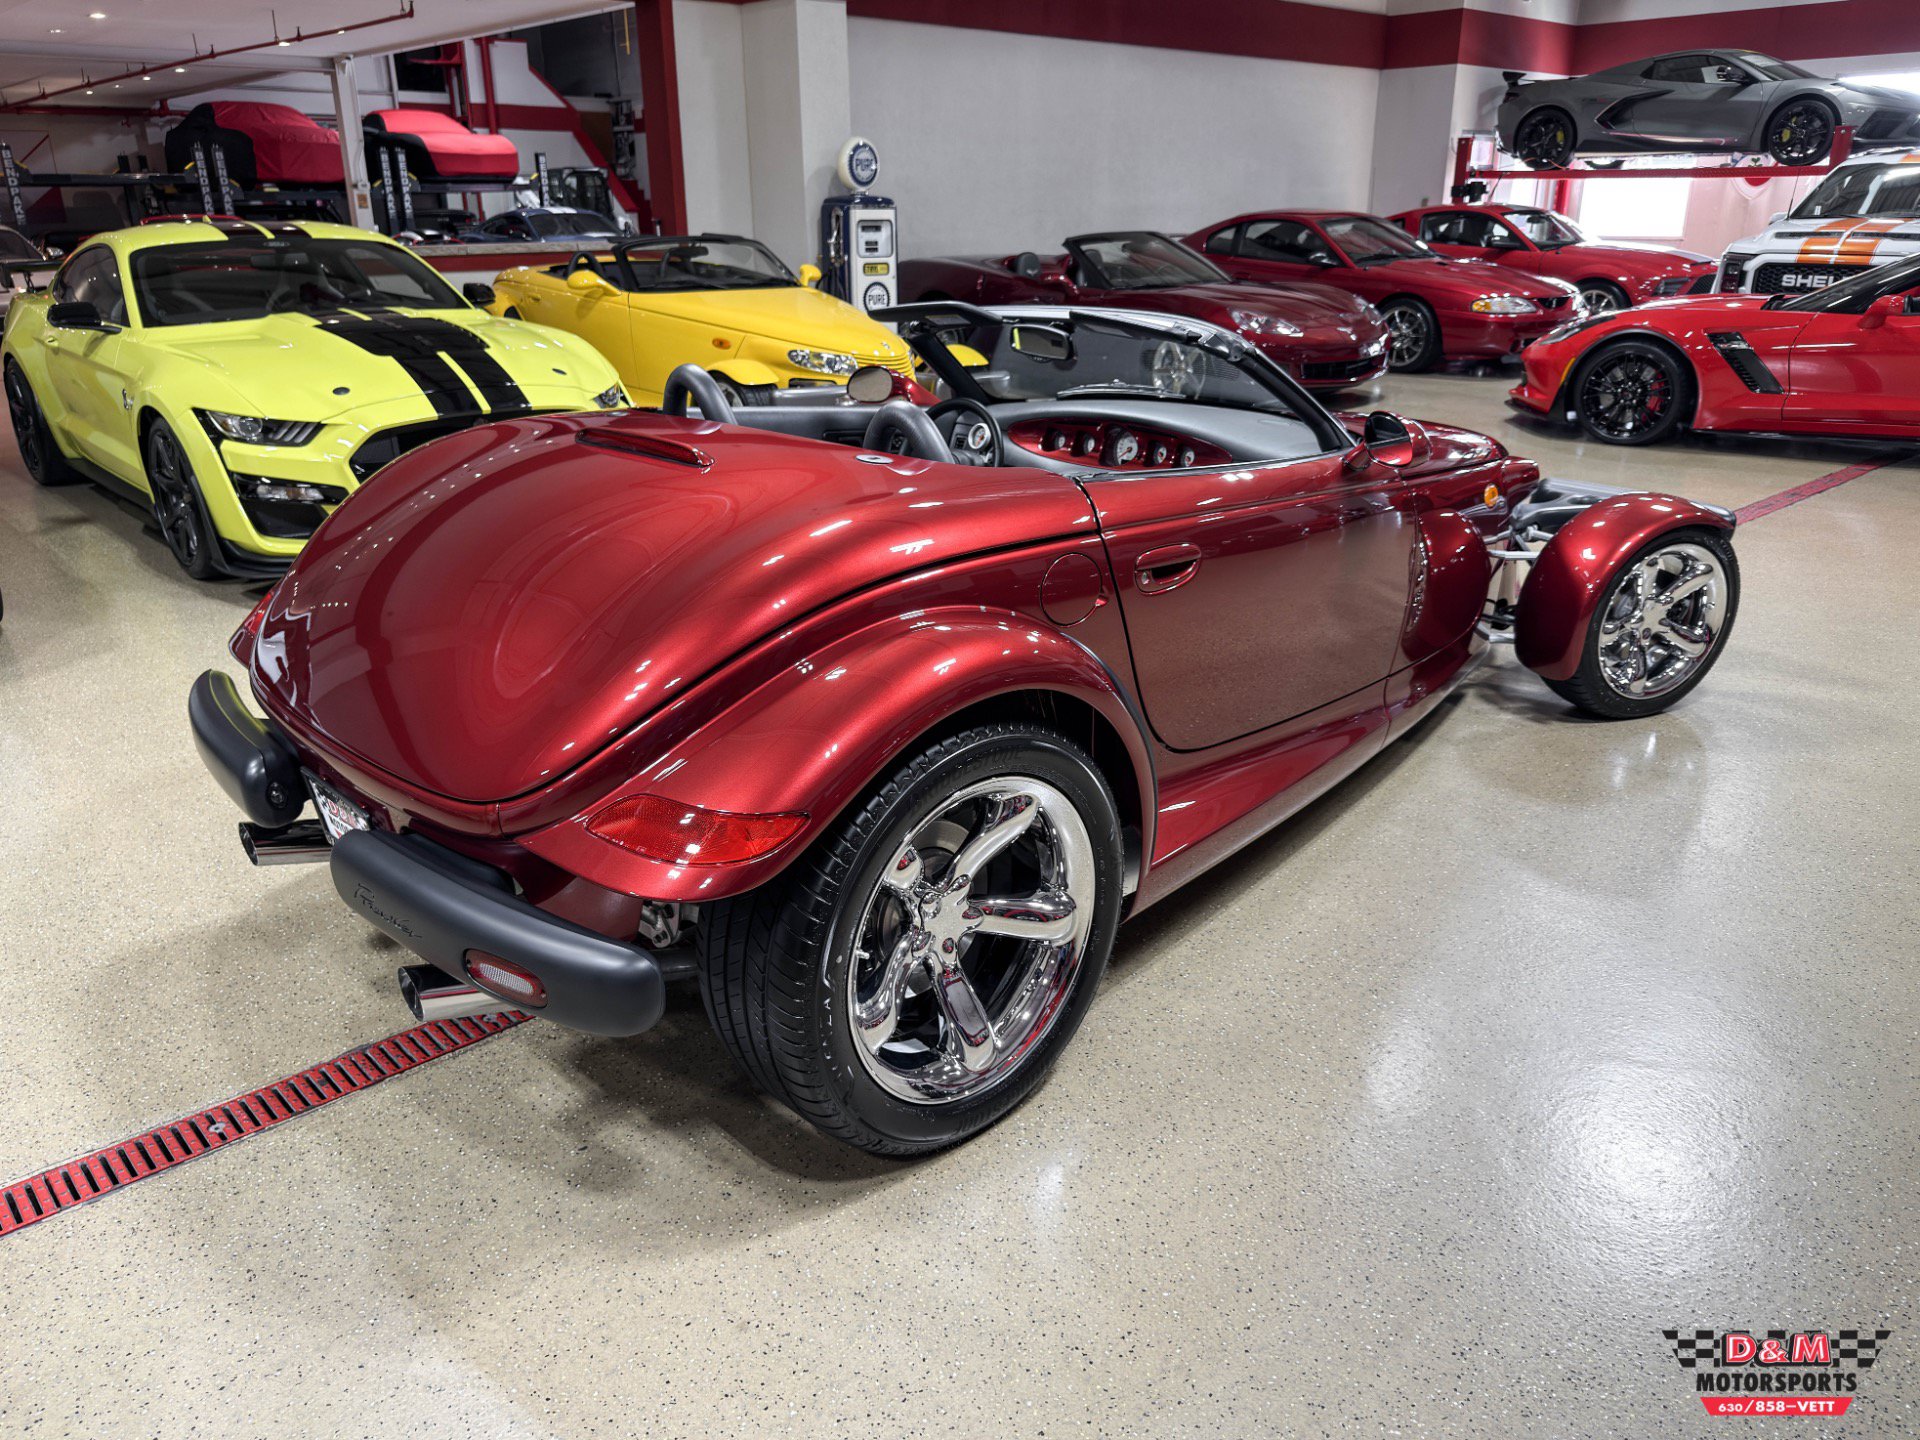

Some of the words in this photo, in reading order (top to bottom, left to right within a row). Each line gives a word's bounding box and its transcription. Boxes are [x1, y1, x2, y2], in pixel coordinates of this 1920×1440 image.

[2, 149, 25, 214] BENDPAK
[195, 151, 214, 211] BENDPAK
[215, 151, 234, 211] BENDPAK
[381, 153, 396, 210] BENDPAK
[398, 153, 412, 210] BENDPAK
[855, 158, 873, 171] PURE
[867, 294, 885, 306] PURE
[1781, 273, 1850, 288] SHEL
